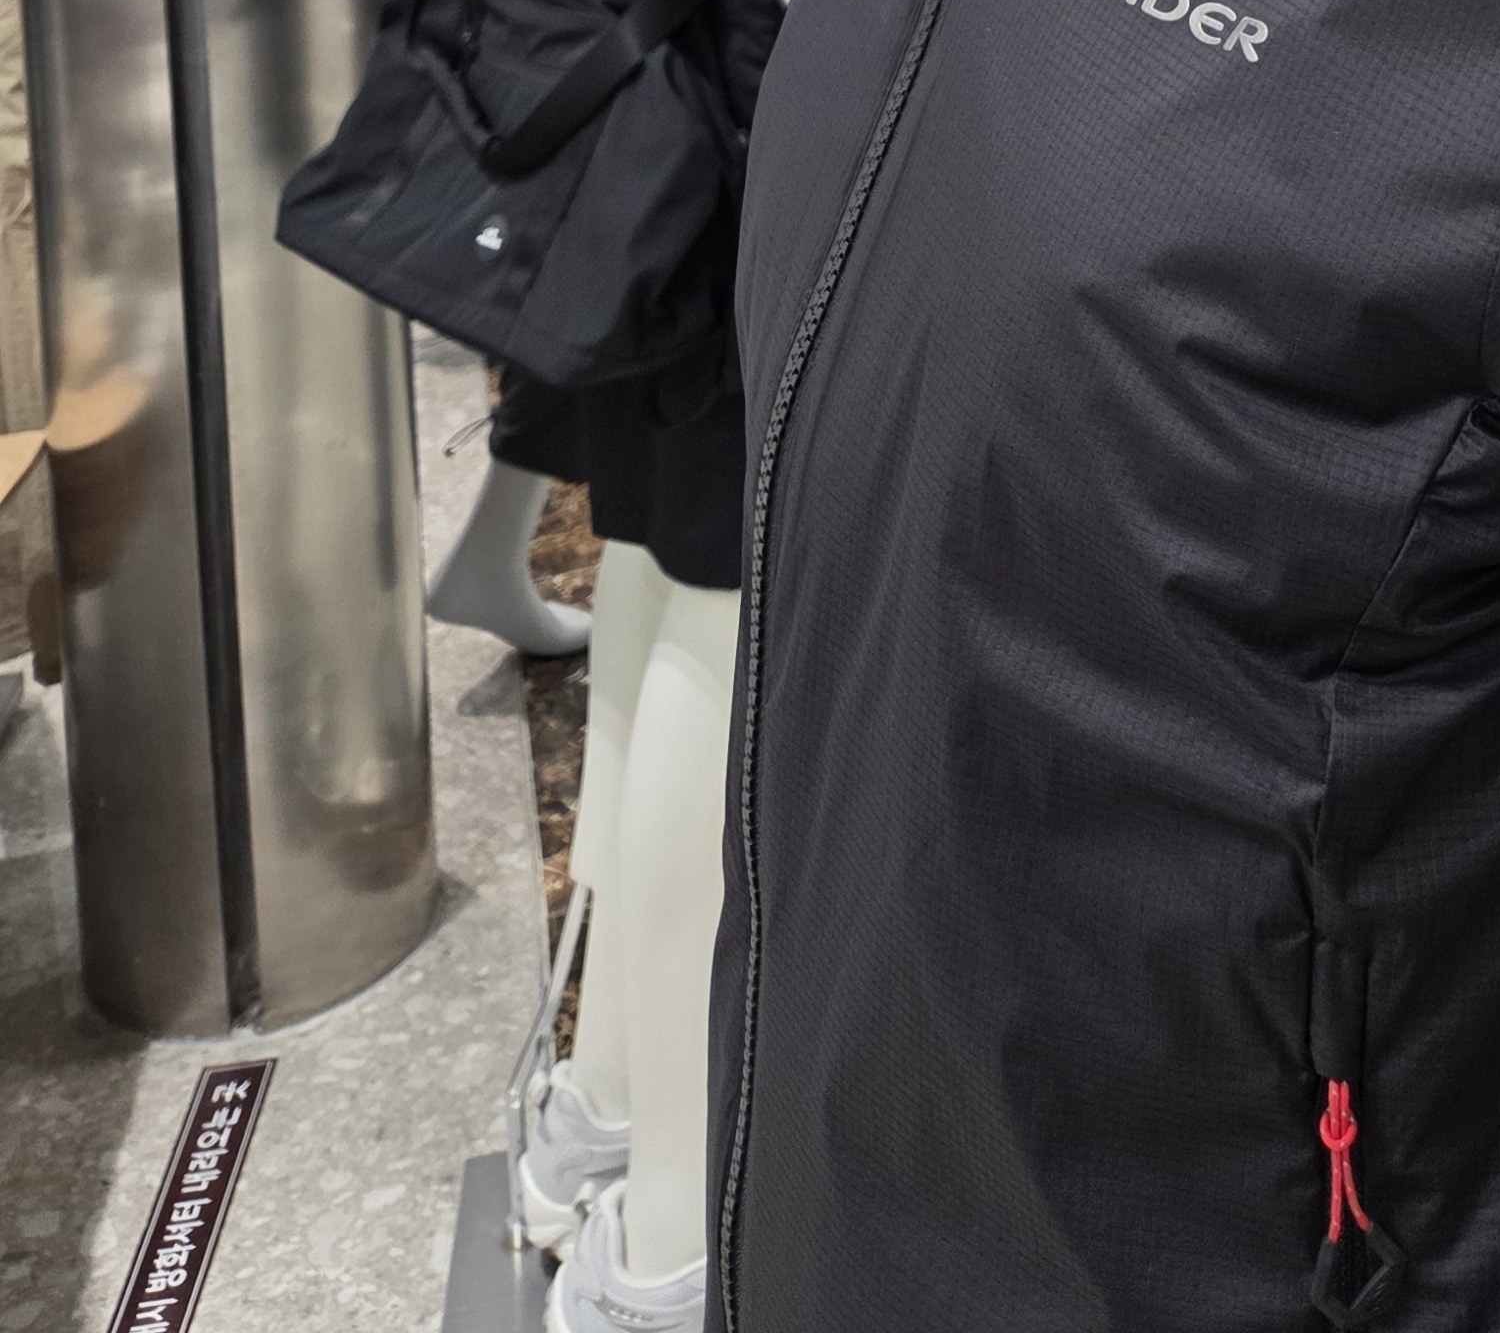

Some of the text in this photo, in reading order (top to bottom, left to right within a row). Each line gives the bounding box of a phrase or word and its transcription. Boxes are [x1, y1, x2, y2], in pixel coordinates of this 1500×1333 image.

[211, 1079, 252, 1104] 곳
[181, 1104, 243, 1194] 내려오는
[144, 1197, 213, 1293] 방화셔터
